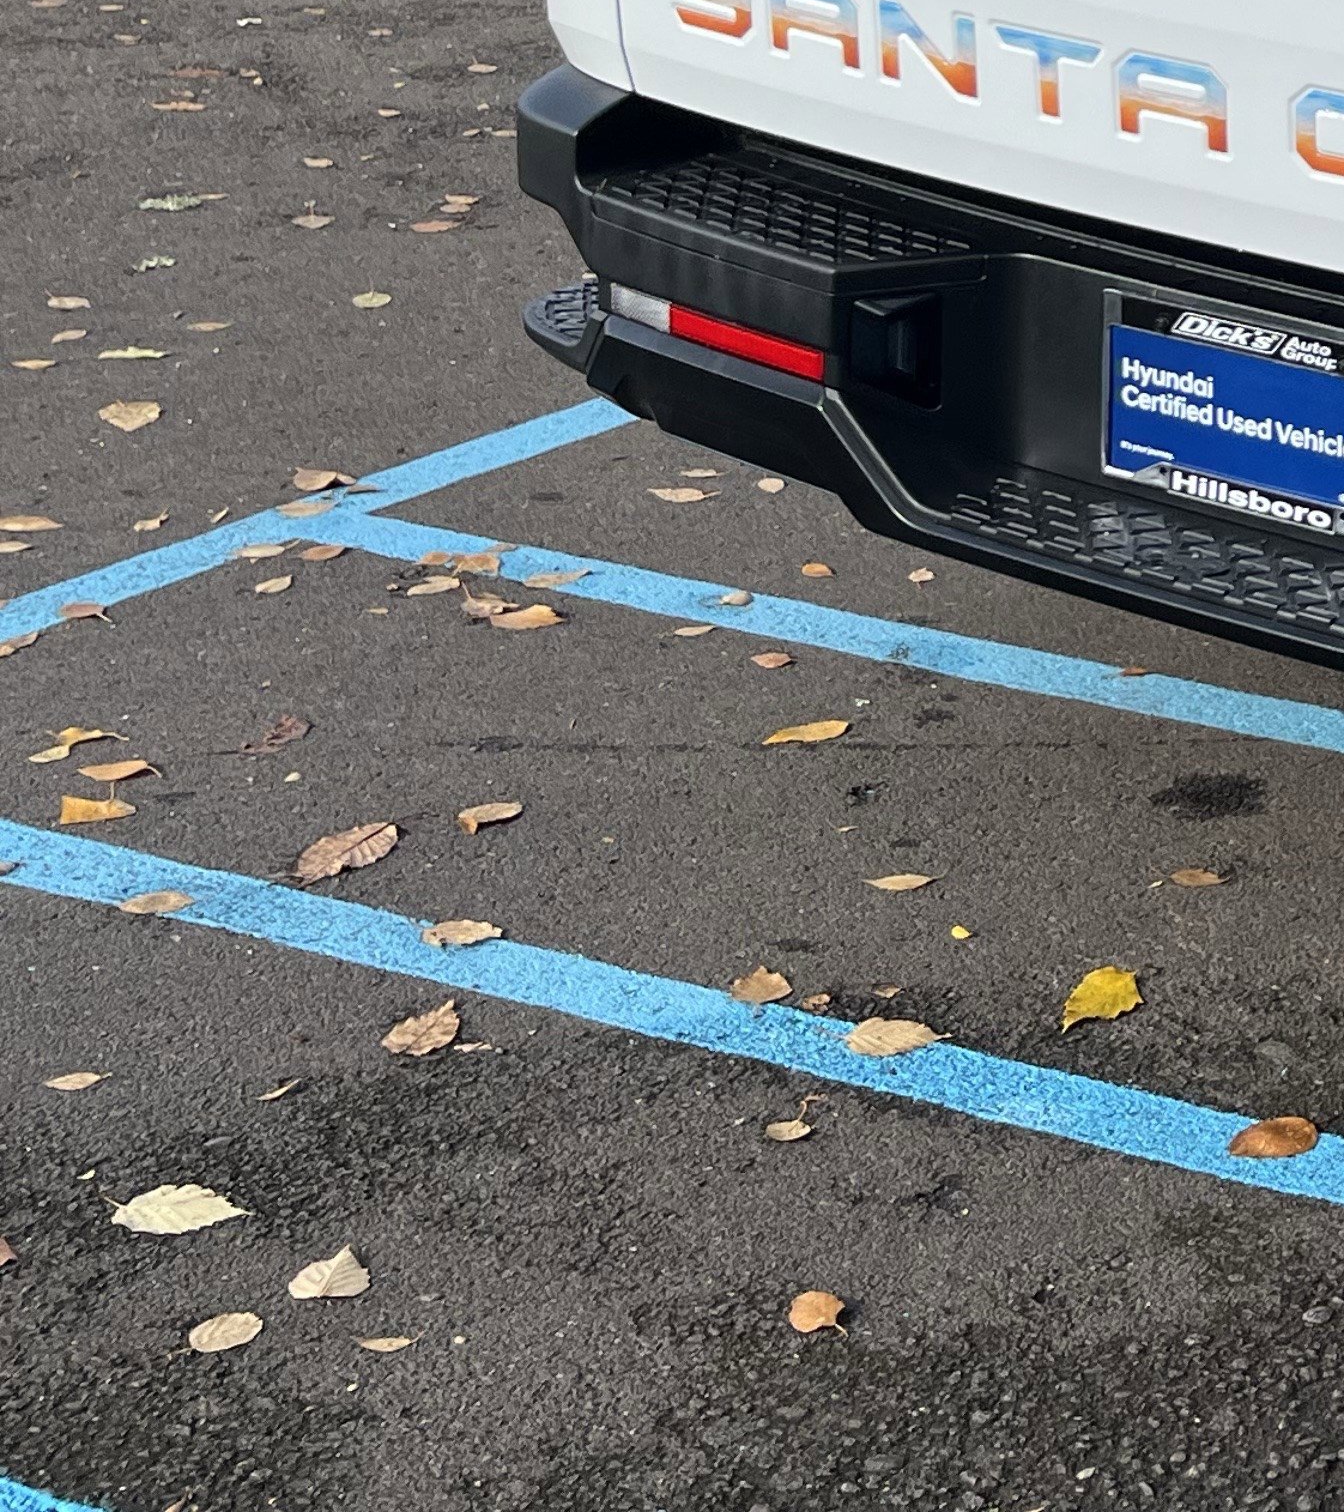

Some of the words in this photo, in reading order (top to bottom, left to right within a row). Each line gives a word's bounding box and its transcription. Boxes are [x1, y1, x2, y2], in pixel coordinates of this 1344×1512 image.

[1177, 316, 1278, 351] Dick's
[1287, 336, 1332, 357] Auto
[1121, 356, 1214, 399] Hyundai
[1121, 384, 1214, 426] Certified
[1216, 406, 1273, 441] Used
[1172, 470, 1332, 529] Hillsboro
